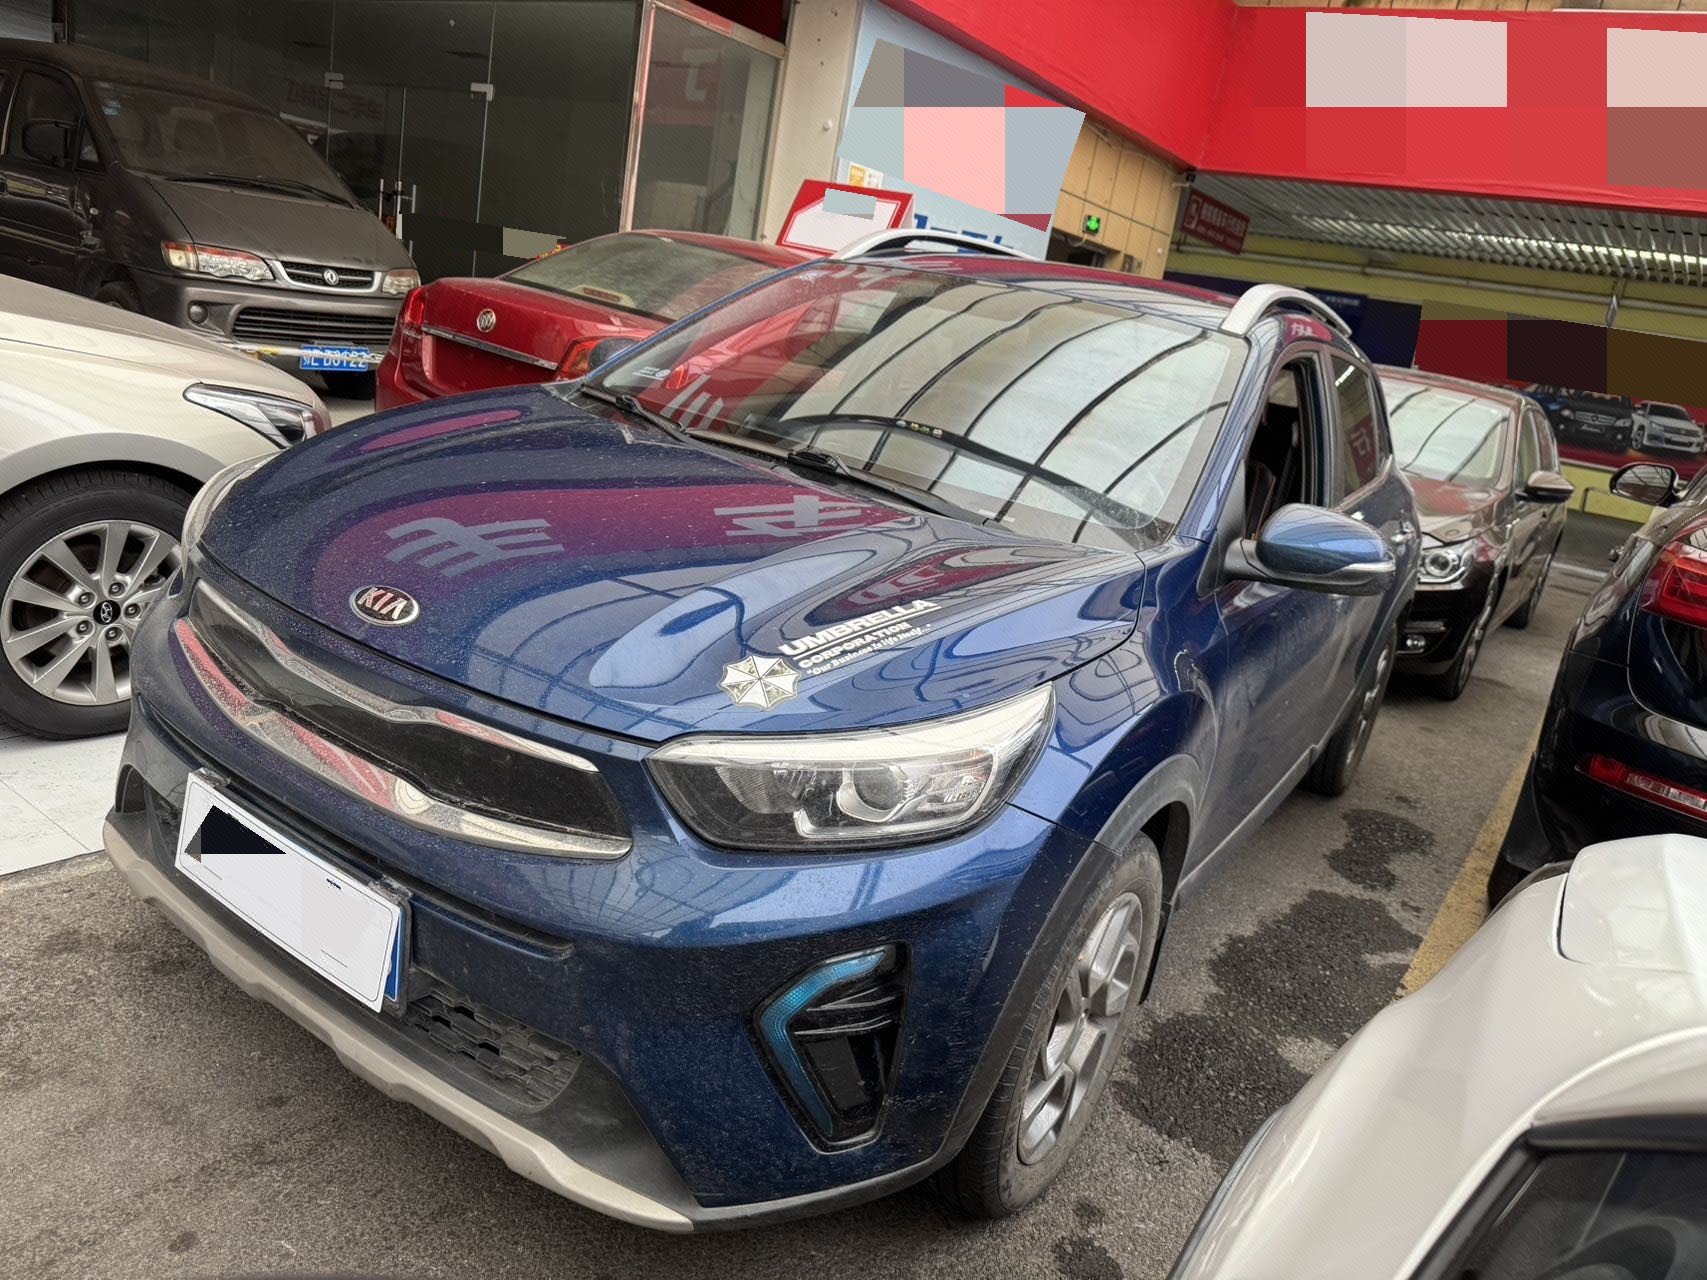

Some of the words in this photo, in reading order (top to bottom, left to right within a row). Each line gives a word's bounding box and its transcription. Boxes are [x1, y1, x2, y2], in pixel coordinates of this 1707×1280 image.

[357, 587, 407, 620] KIA
[778, 599, 938, 655] UMBRELLA
[798, 621, 912, 668] CORPORATION
